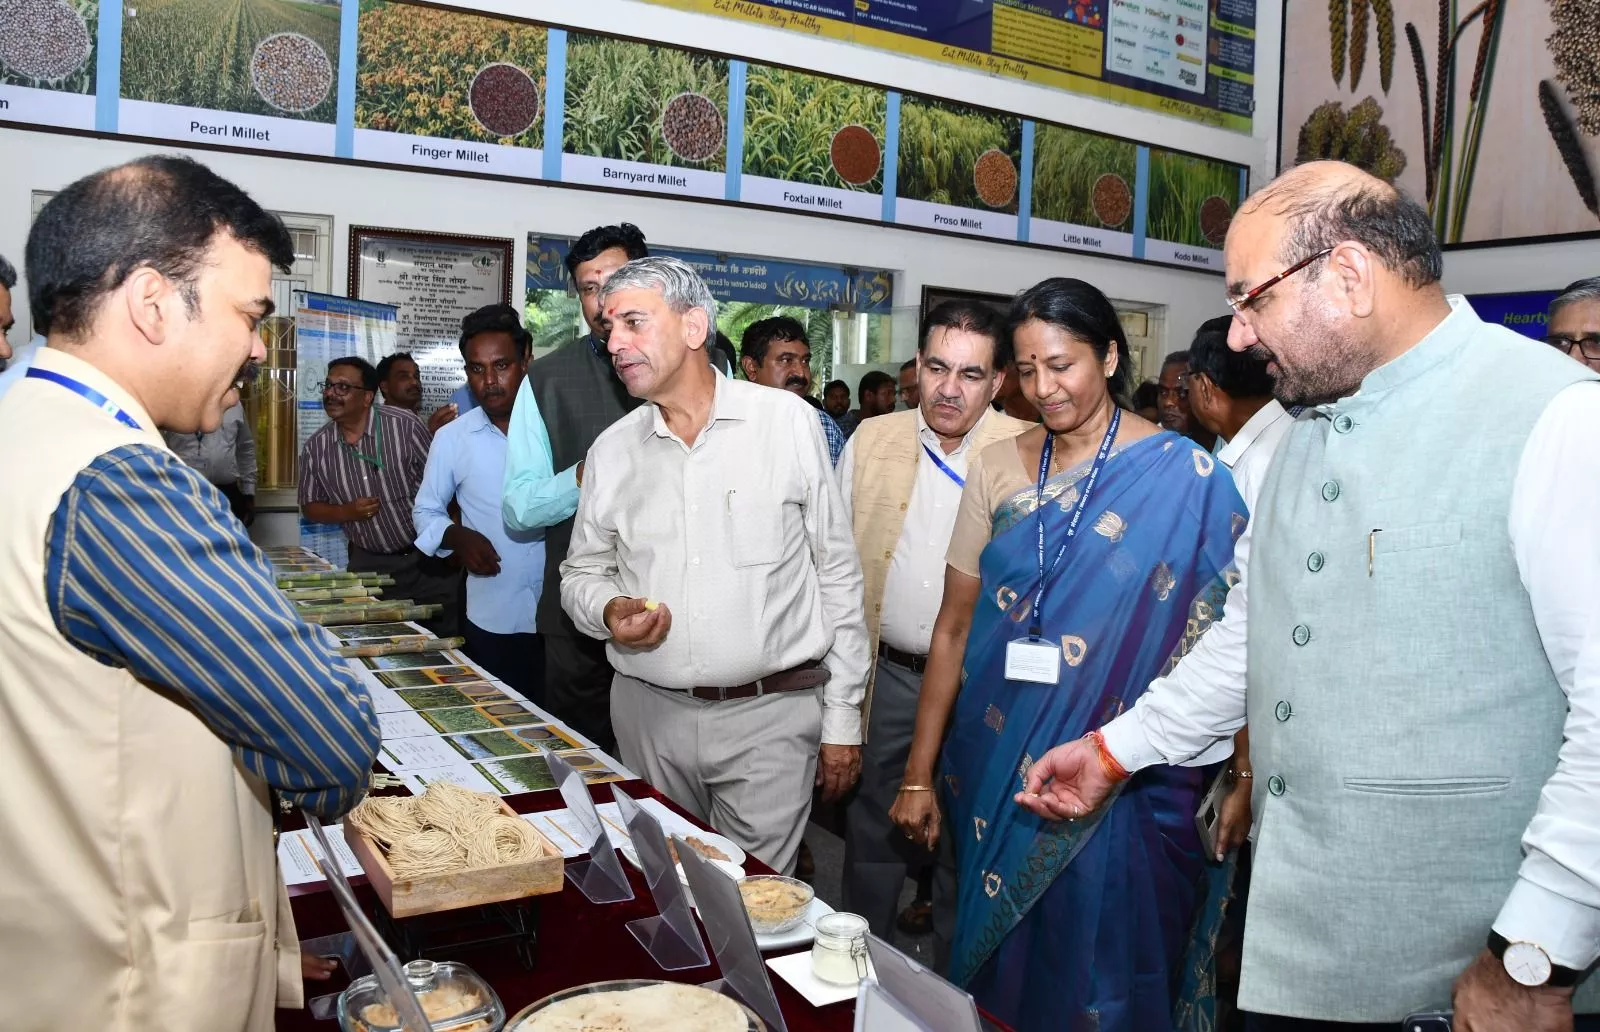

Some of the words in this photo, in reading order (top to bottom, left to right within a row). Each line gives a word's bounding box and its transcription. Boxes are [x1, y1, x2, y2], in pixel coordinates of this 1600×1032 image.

[803, 3, 817, 11] ICAR
[1028, 4, 1052, 16] Metrics
[768, 8, 787, 28] Stay
[790, 12, 821, 35] Healthy
[941, 47, 955, 60] Eat
[1003, 60, 1028, 80] Healthy
[191, 122, 228, 137] Pearl
[232, 125, 270, 141] Millet
[412, 144, 452, 163] Finger
[456, 148, 489, 163] Millet
[603, 167, 655, 186] Barnyard
[657, 174, 687, 187] Millet
[784, 192, 815, 206] Foxtail
[817, 196, 843, 209] Millet
[934, 214, 959, 227] Proso
[960, 218, 982, 230] Millet
[1063, 233, 1081, 245] Little
[1083, 237, 1102, 248] Millet
[1174, 251, 1191, 262] Kodo
[1192, 253, 1209, 265] Millet
[1503, 312, 1549, 325] Hearty
